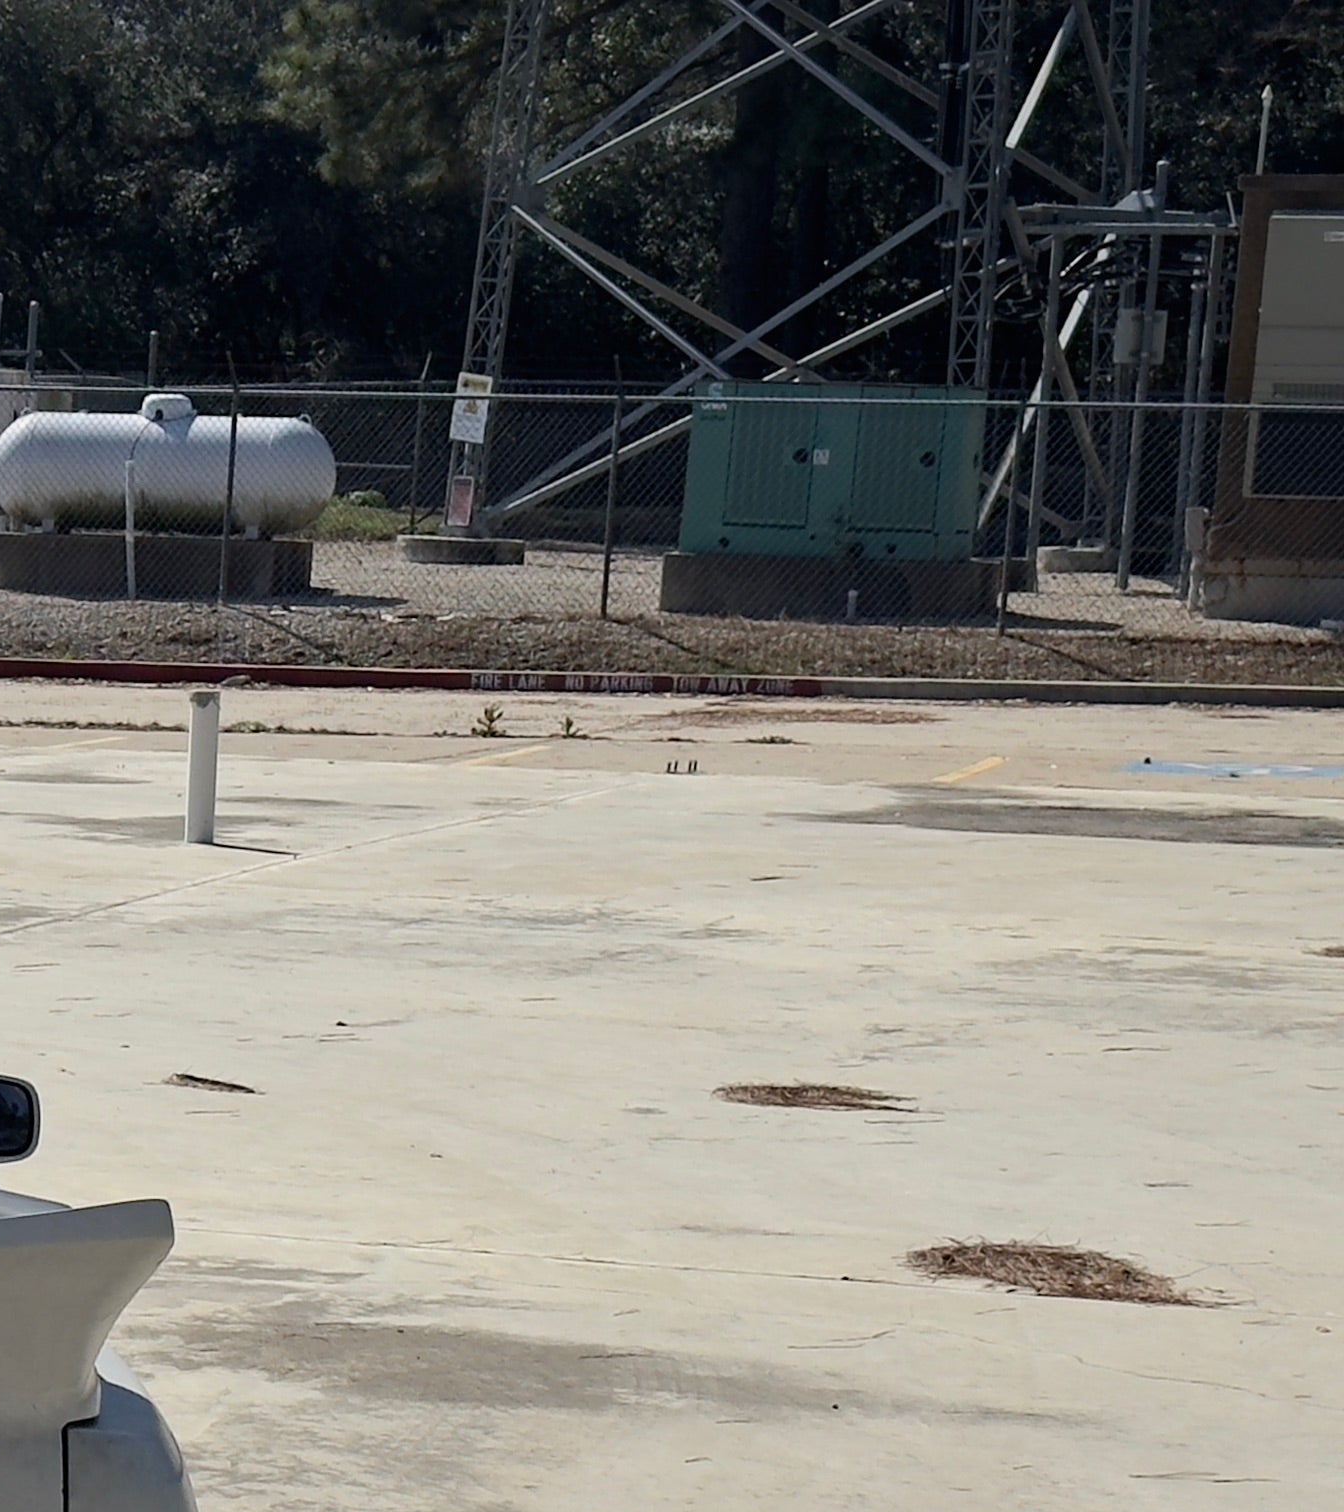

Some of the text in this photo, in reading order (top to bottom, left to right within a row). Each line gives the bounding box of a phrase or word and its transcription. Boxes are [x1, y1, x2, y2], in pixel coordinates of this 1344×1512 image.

[470, 673, 503, 689] FIRE
[508, 674, 547, 689] LANE
[564, 675, 584, 690] NO
[590, 675, 654, 692] PARKING
[705, 677, 750, 694] AWAY
